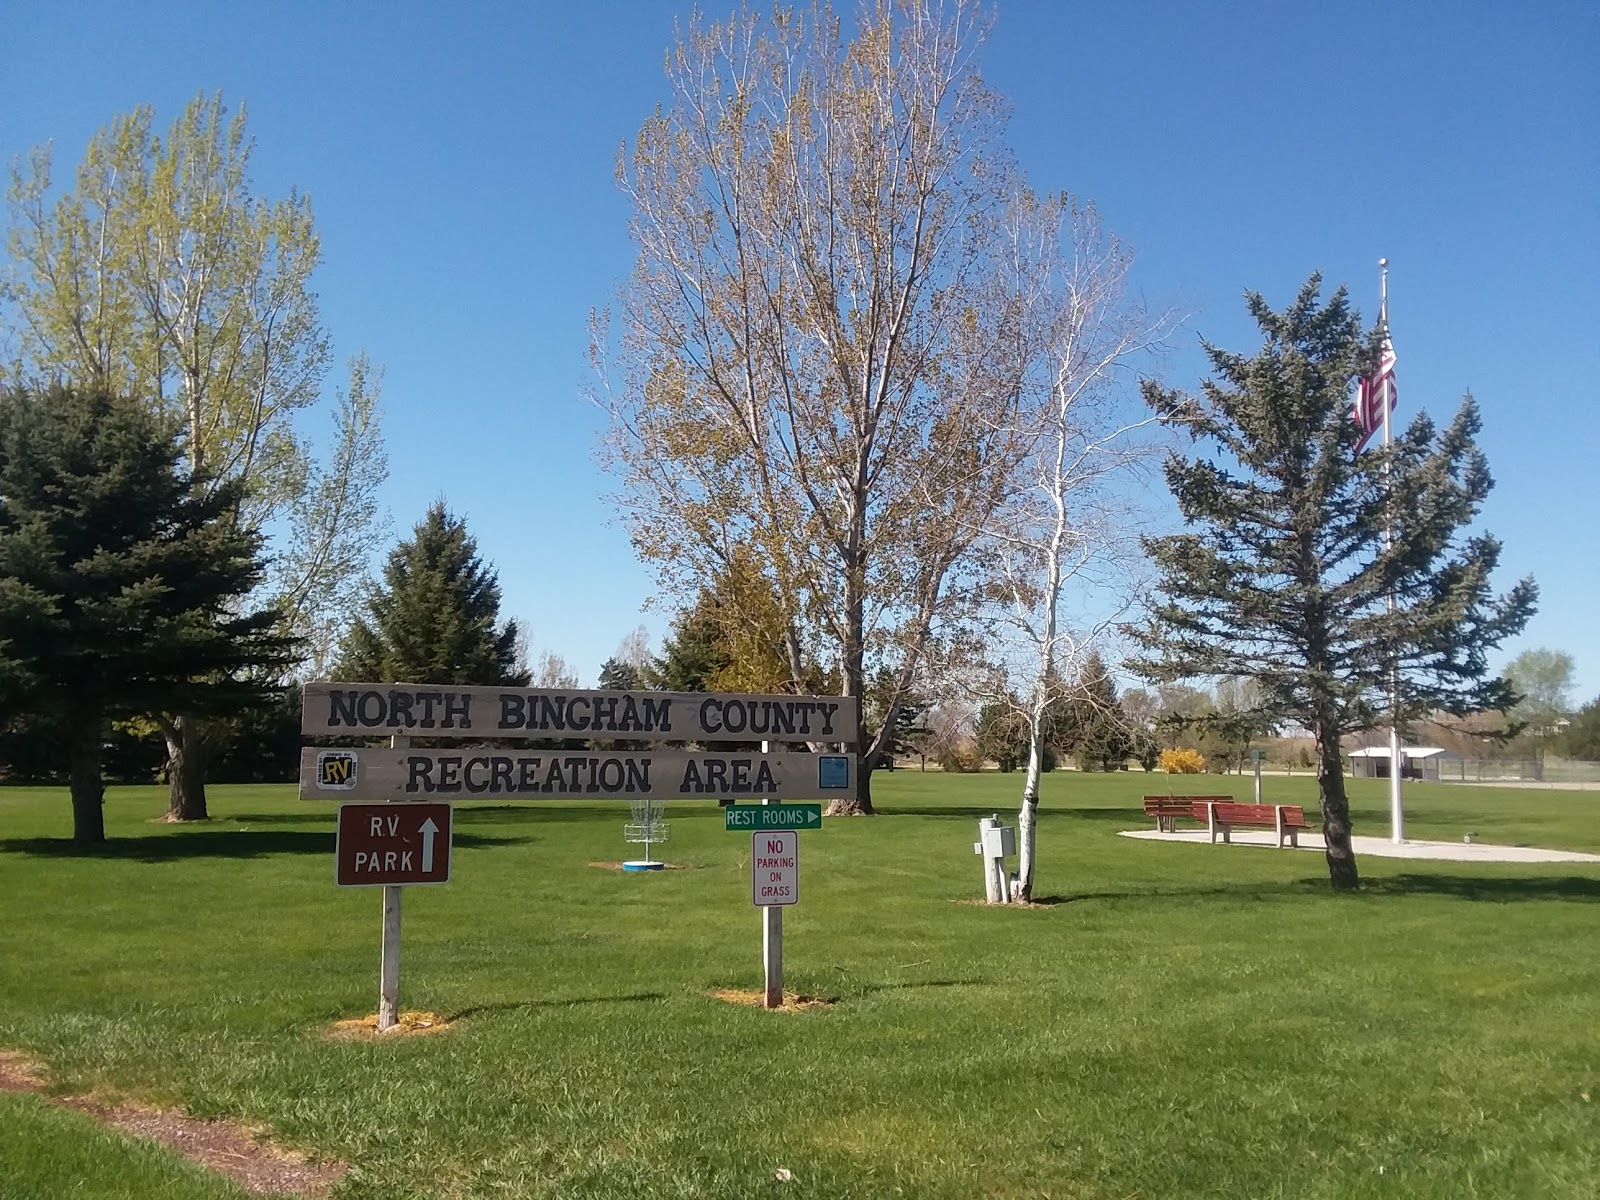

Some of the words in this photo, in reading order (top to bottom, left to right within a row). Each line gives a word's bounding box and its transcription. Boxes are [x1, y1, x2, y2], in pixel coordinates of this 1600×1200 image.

[328, 690, 471, 728] NORTH
[498, 693, 671, 732] BINGHAM
[700, 698, 838, 735] COUNTY
[323, 759, 351, 782] RV
[405, 756, 651, 793] RECREATION
[680, 759, 777, 793] AREA
[727, 810, 756, 825] REST
[762, 810, 803, 824] ROOMS
[767, 840, 783, 854] NO
[355, 851, 413, 872] PARK
[757, 857, 794, 868] PARKING
[770, 872, 782, 882] ON
[761, 886, 790, 897] GRASS
